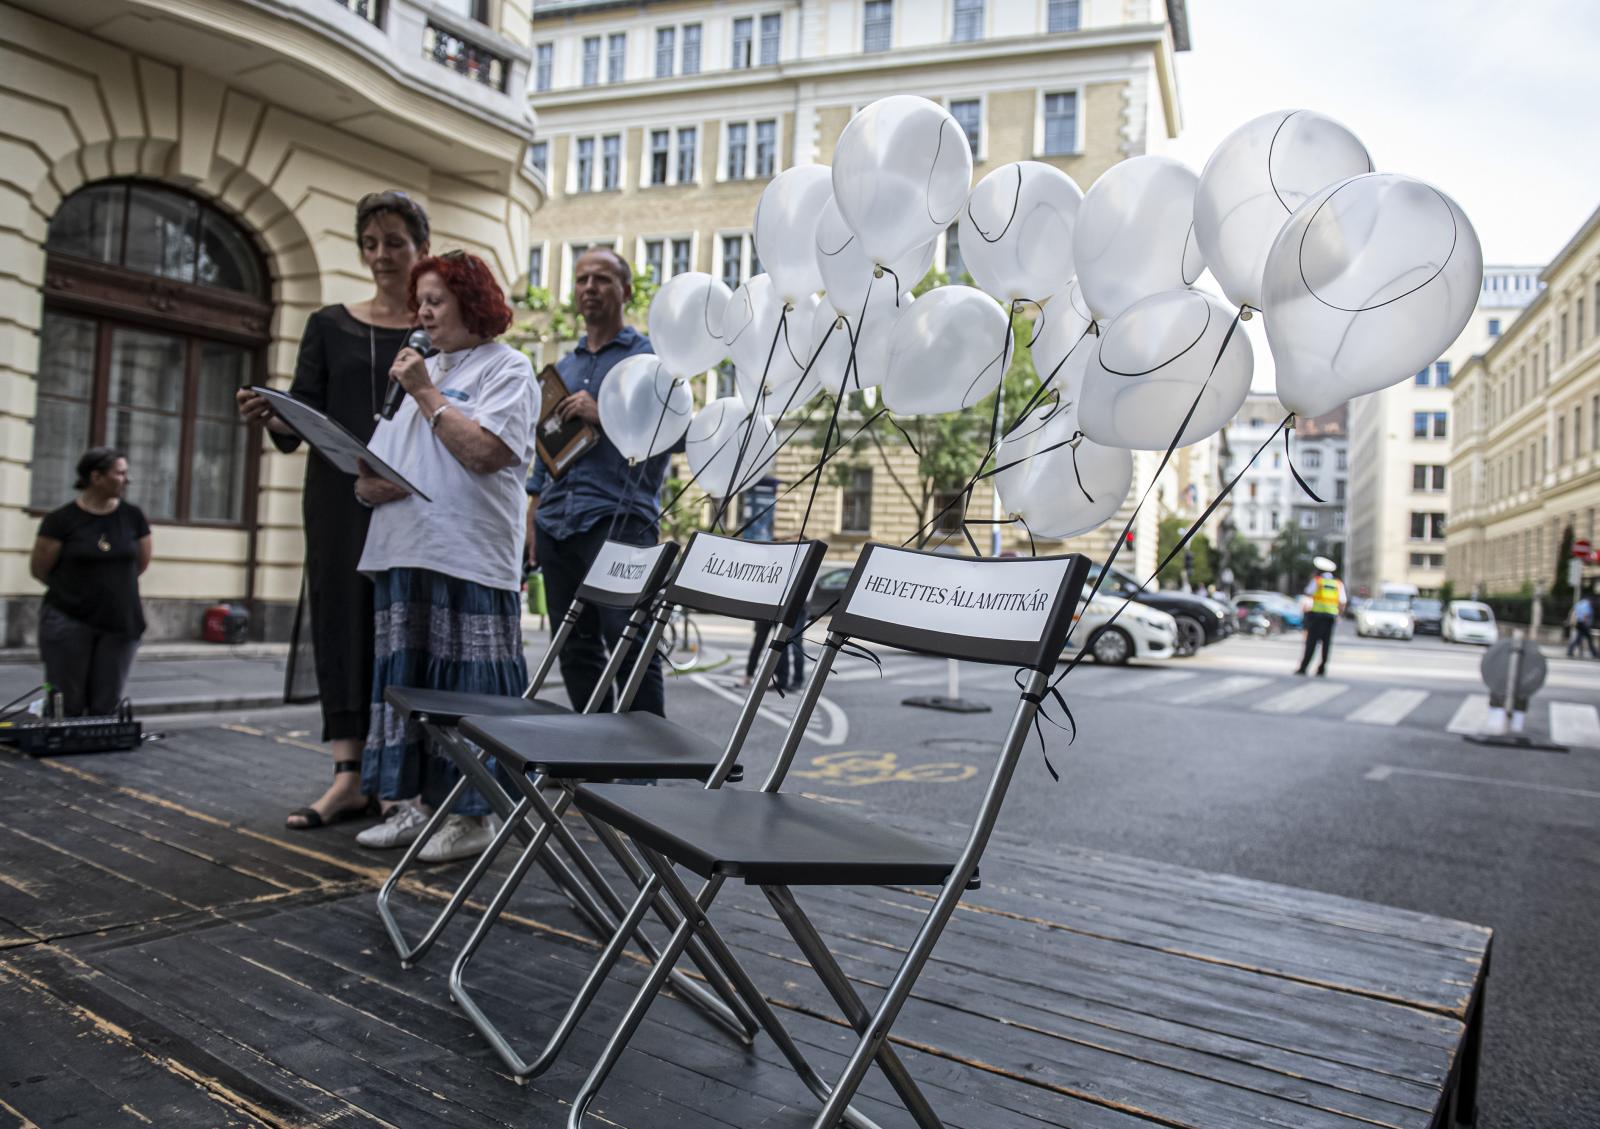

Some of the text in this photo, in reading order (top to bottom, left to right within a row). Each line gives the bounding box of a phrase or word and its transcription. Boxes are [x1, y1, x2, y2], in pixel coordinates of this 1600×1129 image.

[702, 552, 783, 584] ÁLLAMTITKÁR
[864, 575, 1049, 611] HELYETTES ÁLLAMTITKÁR
